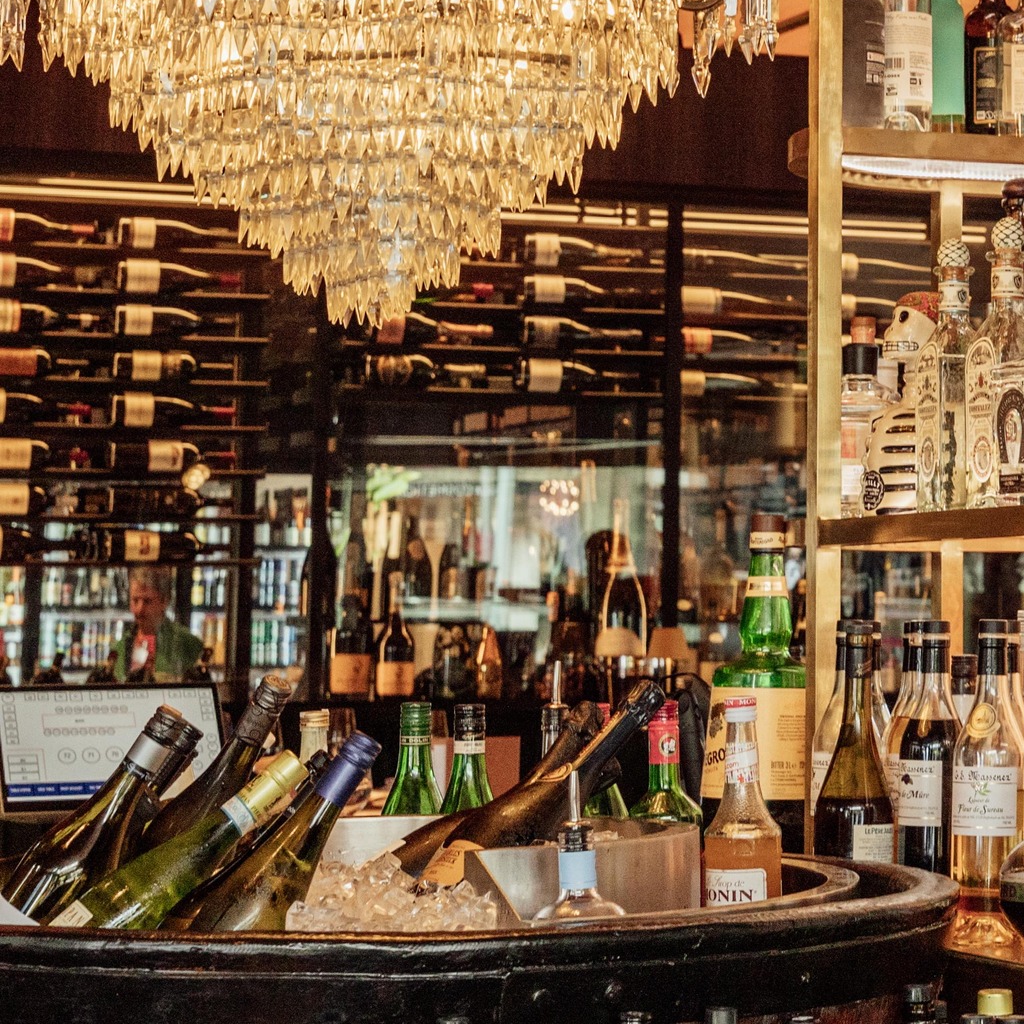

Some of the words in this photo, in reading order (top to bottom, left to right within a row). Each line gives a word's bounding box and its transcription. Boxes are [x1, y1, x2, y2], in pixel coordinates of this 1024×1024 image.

[968, 770, 1011, 781] Massenez
[957, 805, 972, 814] Fleur
[979, 805, 1004, 815] Sureau
